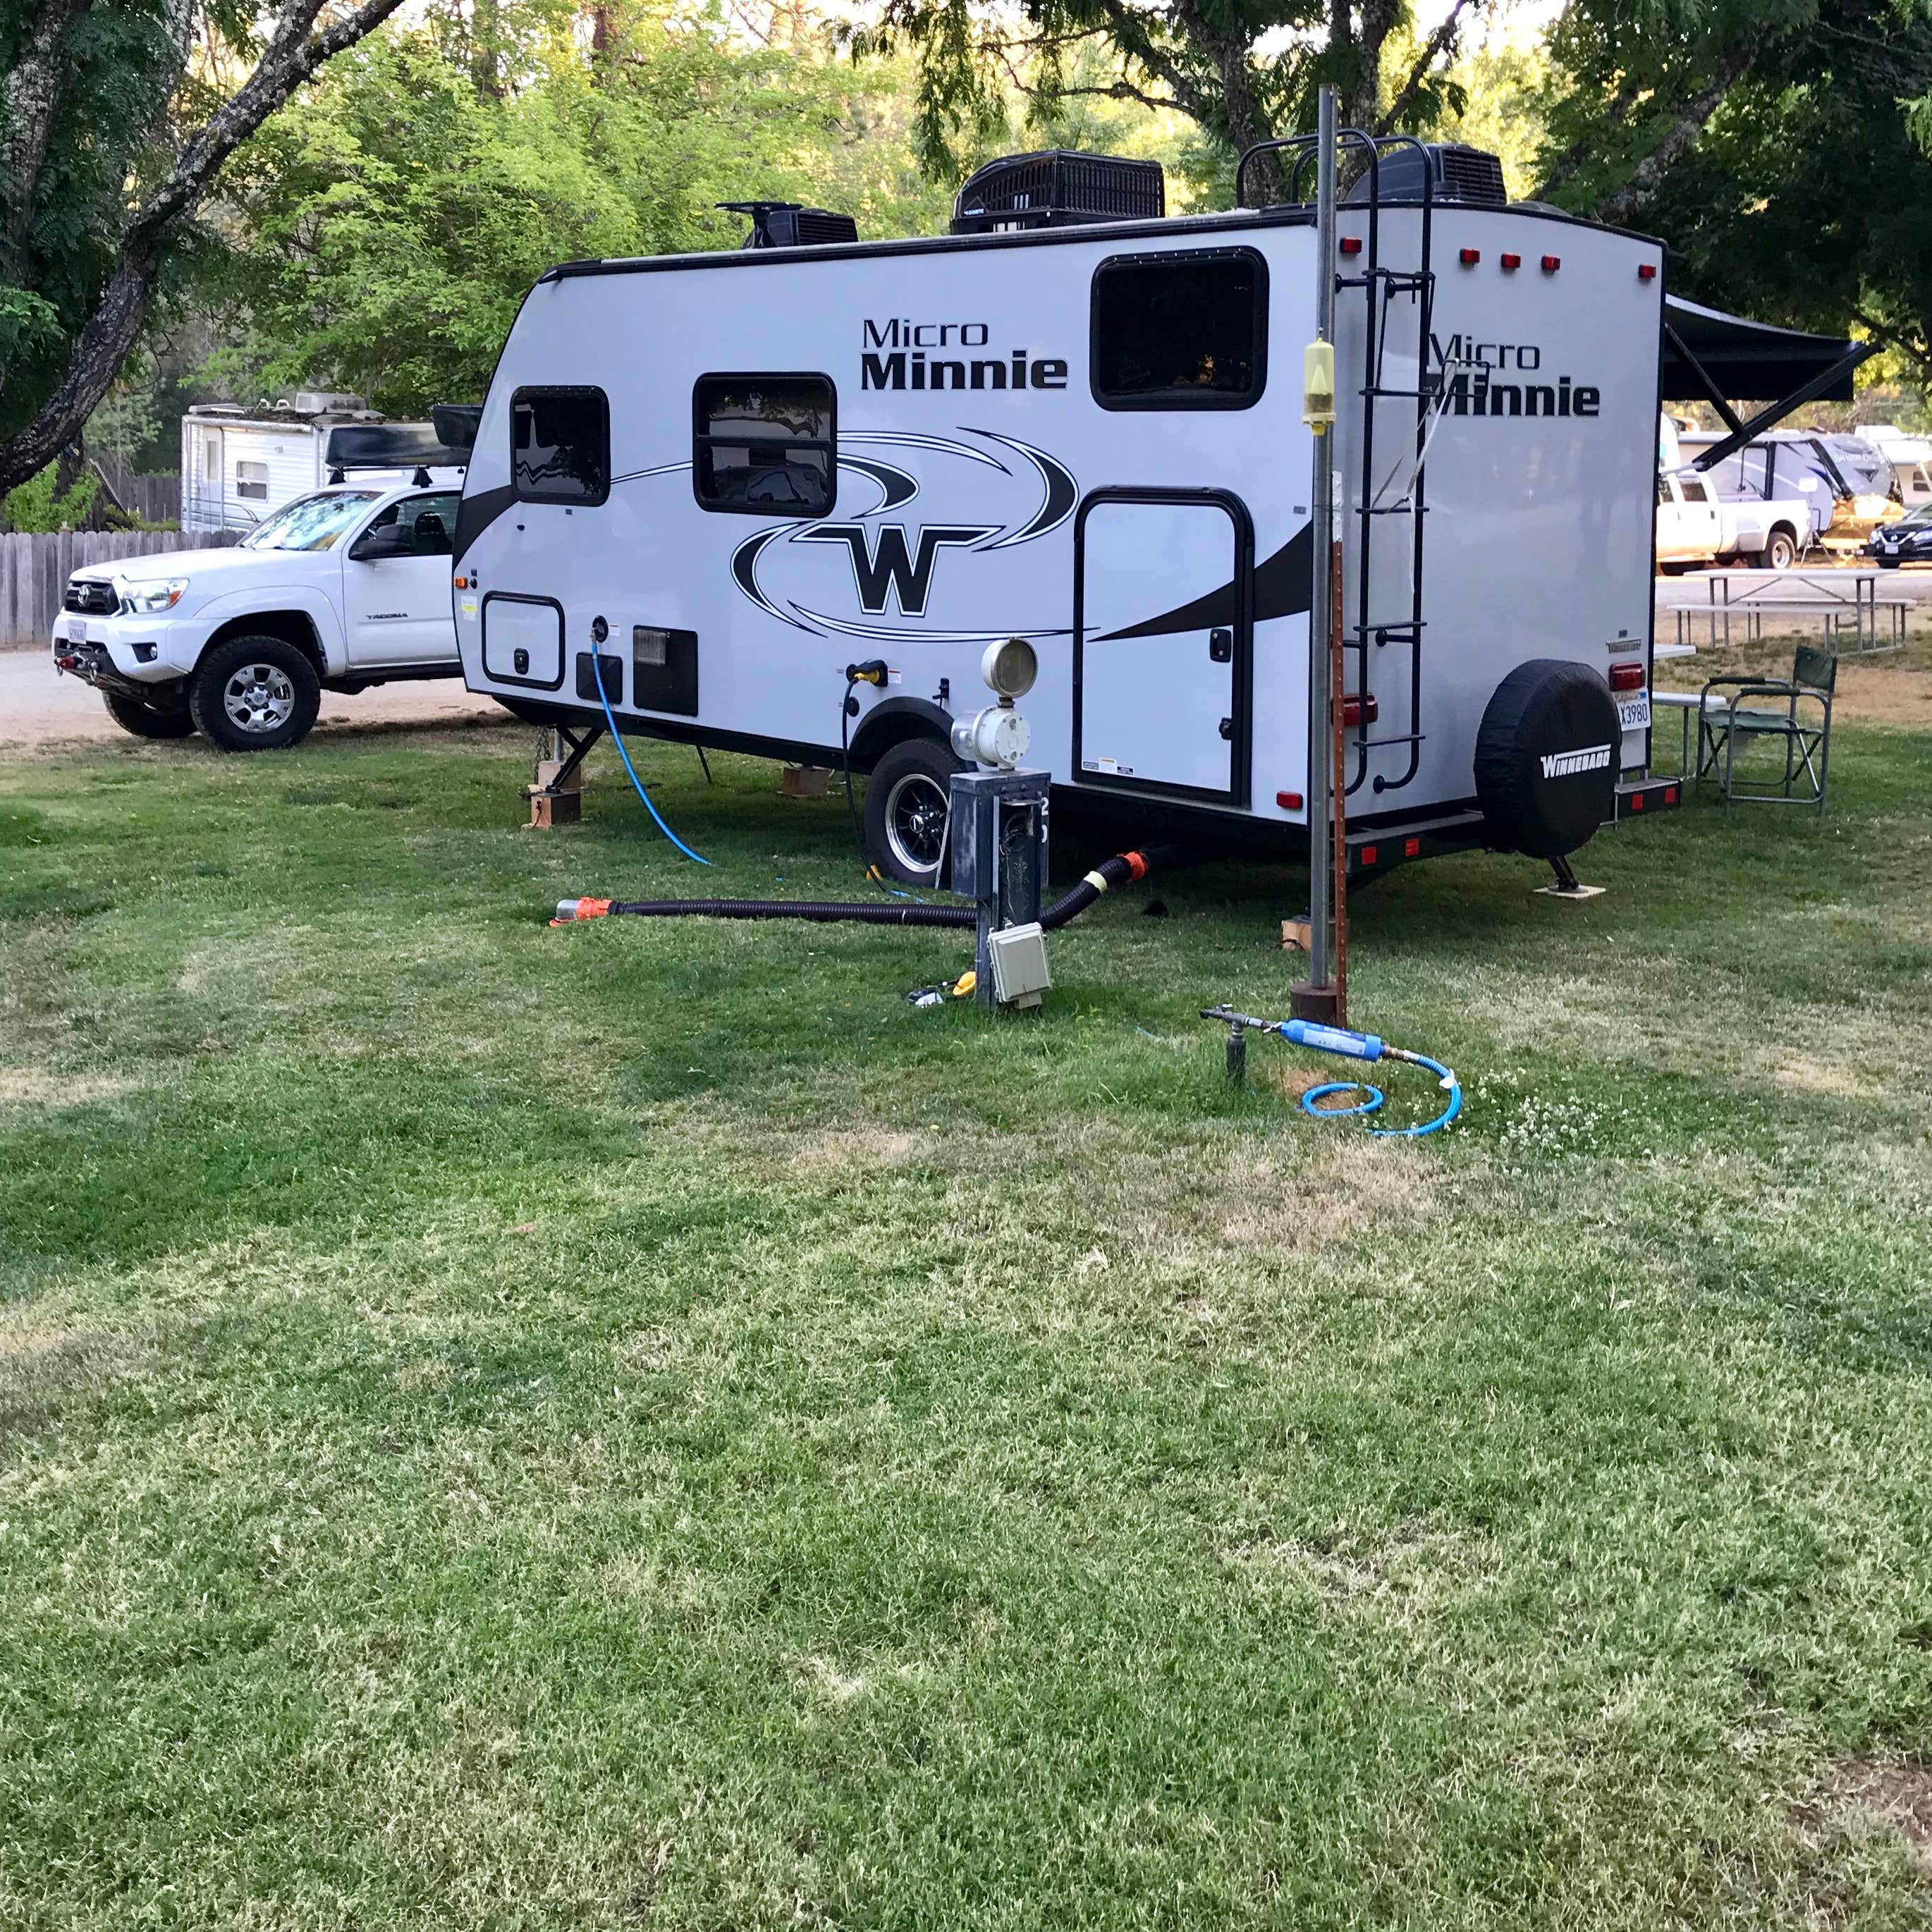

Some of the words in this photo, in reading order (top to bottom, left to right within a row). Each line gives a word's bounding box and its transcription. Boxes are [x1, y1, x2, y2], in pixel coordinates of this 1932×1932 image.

[864, 319, 988, 348] Micro
[1429, 334, 1540, 369] Micro
[861, 350, 1068, 390] Minnie
[1426, 375, 1600, 416] Minnie
[789, 522, 1006, 618] W
[1621, 704, 1648, 725] X3980
[1541, 743, 1611, 779] WINNEBAGO
